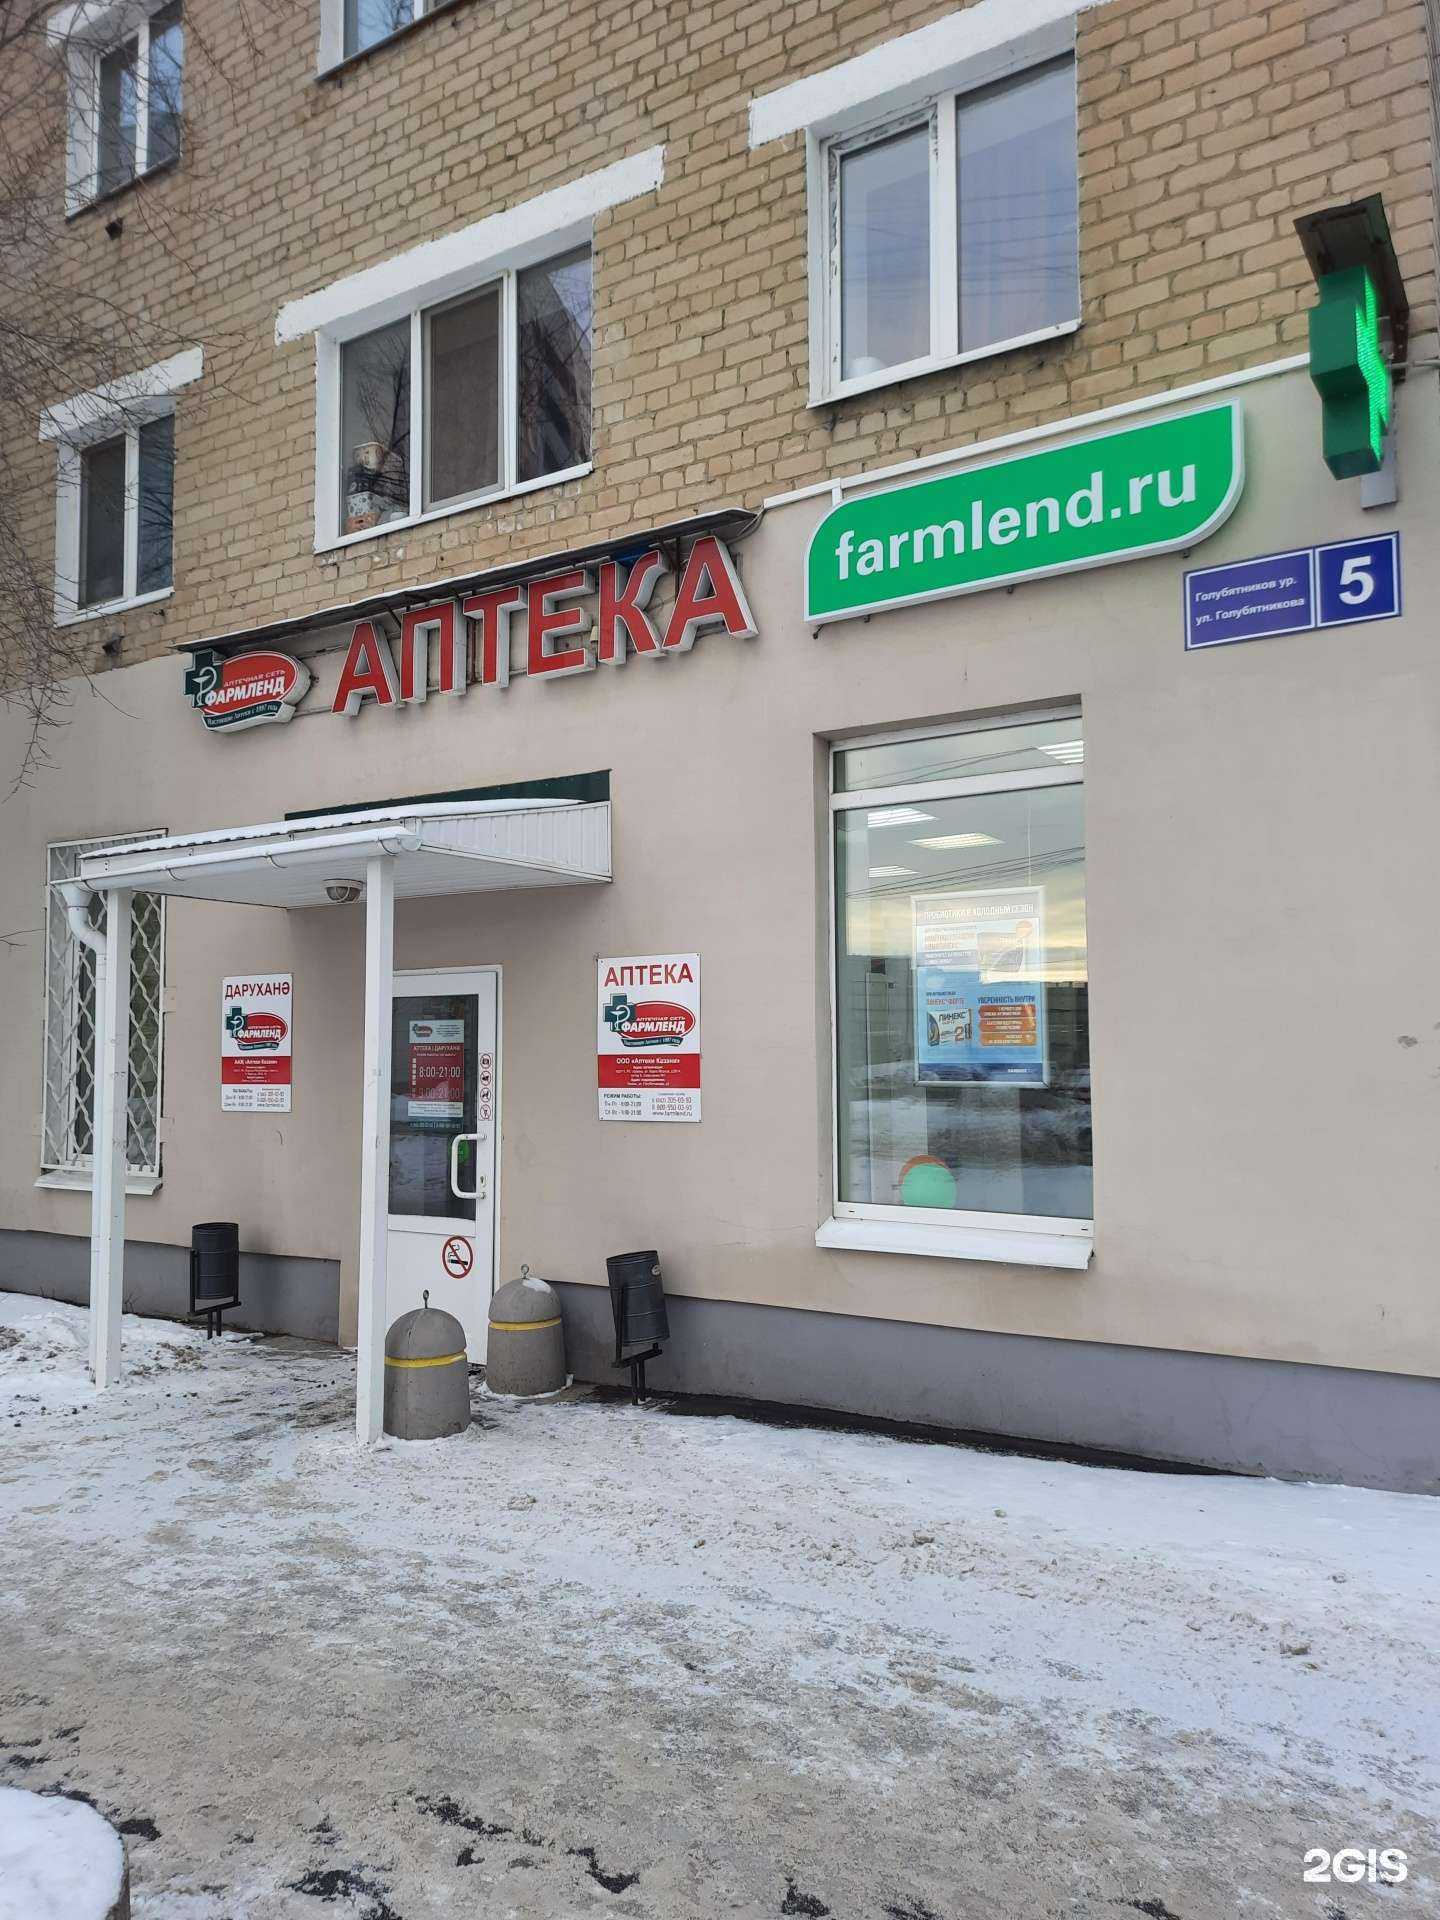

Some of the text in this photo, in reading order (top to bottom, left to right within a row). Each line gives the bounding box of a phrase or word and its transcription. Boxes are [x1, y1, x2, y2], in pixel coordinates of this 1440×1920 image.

[835, 464, 1198, 580] farmlend.ru
[1195, 576, 1297, 602] Голубятников ур.
[1338, 555, 1376, 605] 5
[1195, 596, 1305, 626] ул. Голубятникова
[331, 535, 754, 716] АПТЕКА
[204, 675, 286, 706] ФАРМЛЕНД
[223, 669, 286, 688] АПТЕЧНАЯ СЕТЬ
[604, 963, 694, 987] АПТЕКА
[225, 981, 290, 1000] ДАРУХАНӘ
[236, 1028, 282, 1041] ФАРМЛЕНД
[620, 1020, 686, 1034] ФАРМЛЕНД
[419, 1066, 461, 1078] 8:00-21:00
